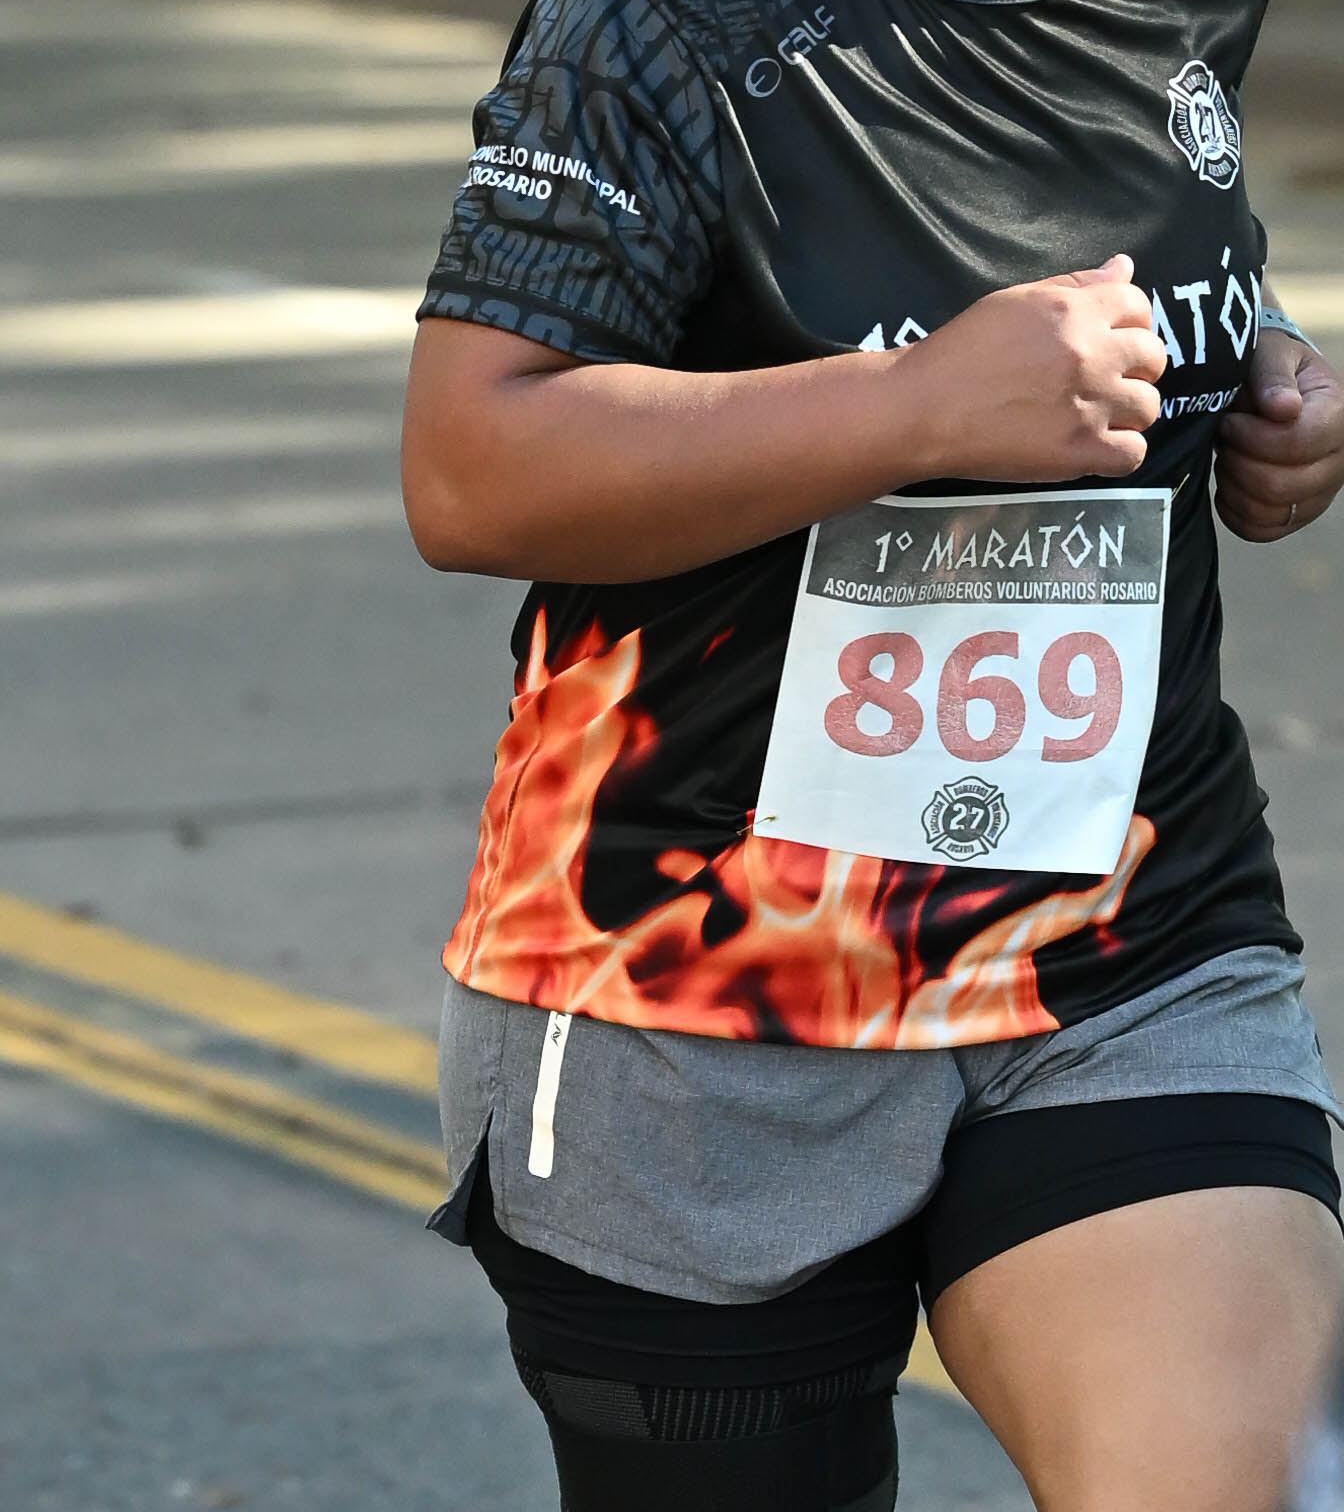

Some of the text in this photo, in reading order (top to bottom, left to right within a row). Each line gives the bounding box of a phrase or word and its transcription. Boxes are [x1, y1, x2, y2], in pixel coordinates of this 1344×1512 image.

[469, 144, 529, 168] ONCEJO
[921, 510, 1126, 572] MARATÓN
[822, 576, 1158, 604] ASOCIACIÓN BOMBEROS VOLUNTARIOS ROSARIO
[823, 629, 1124, 763] 869
[949, 802, 985, 831] 27
